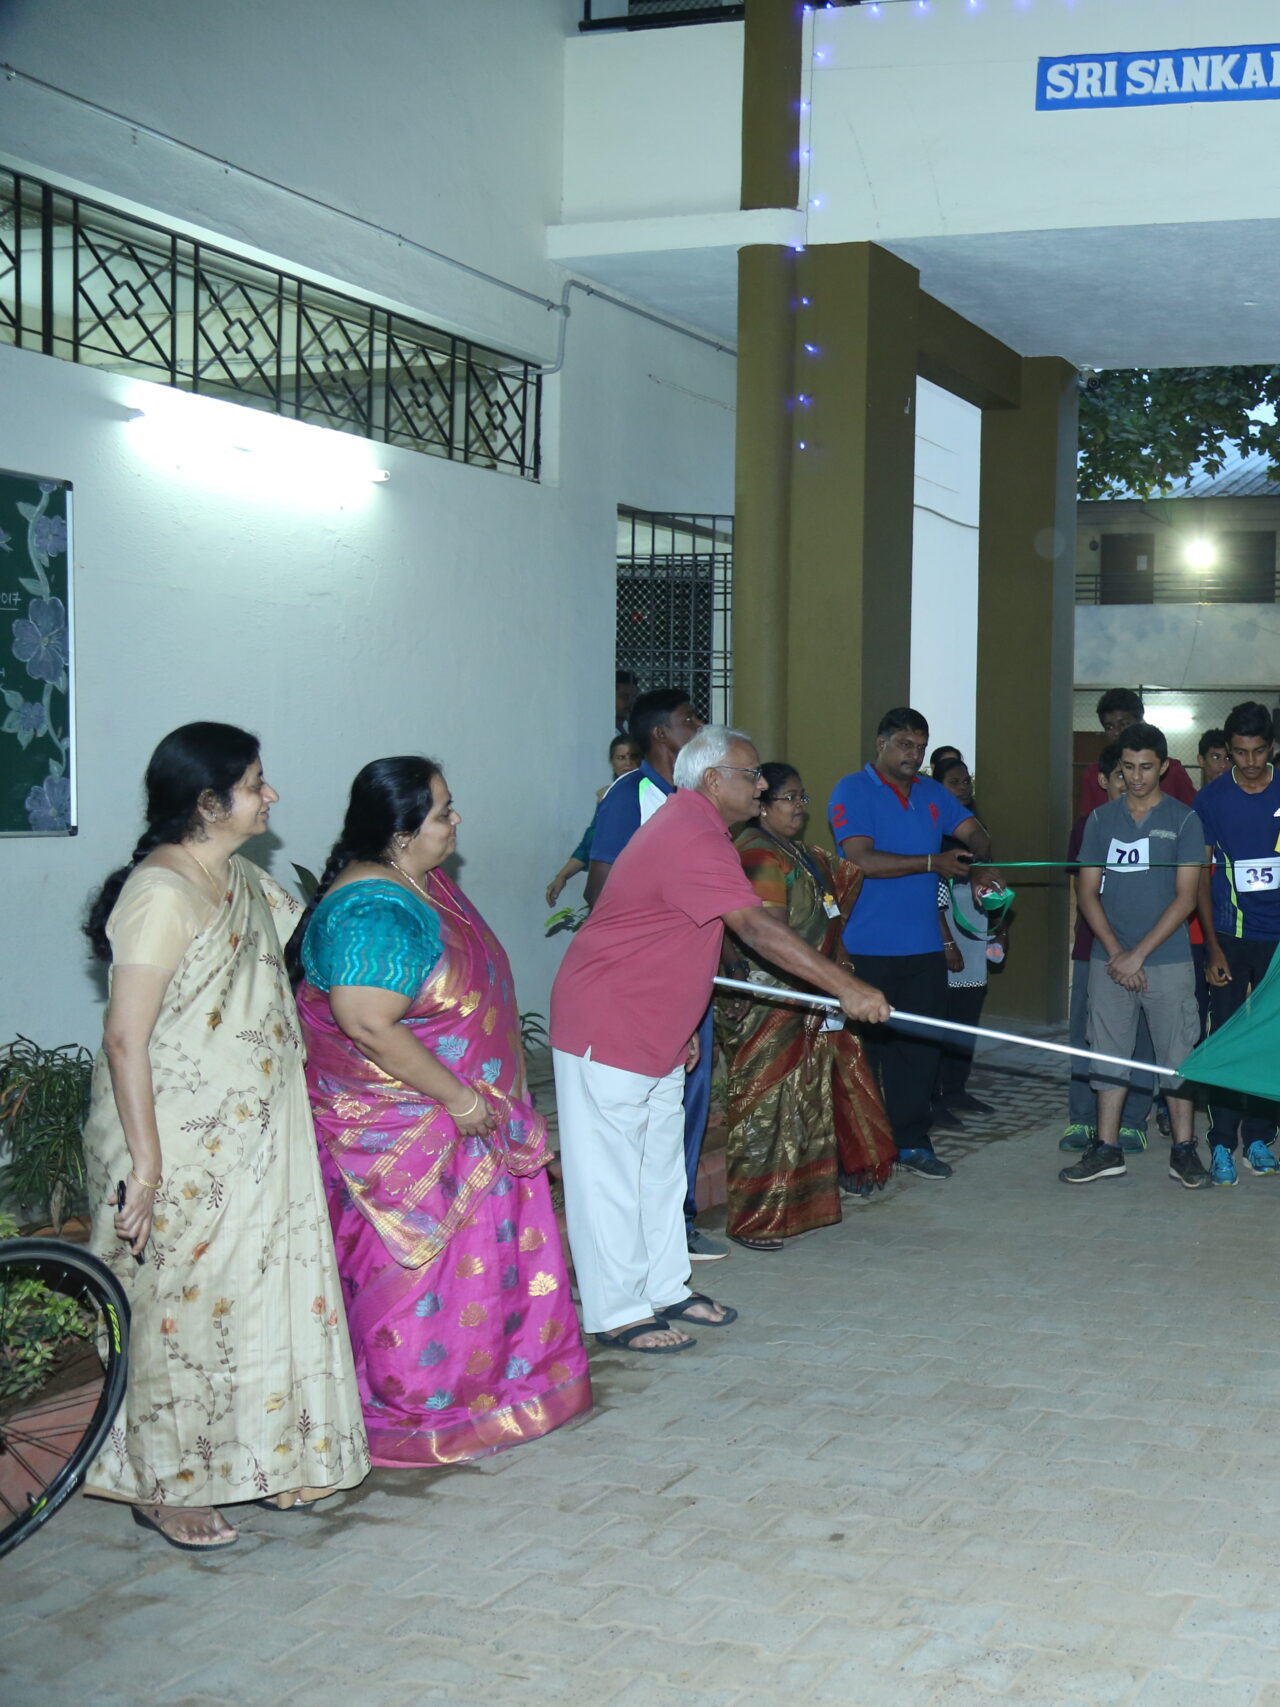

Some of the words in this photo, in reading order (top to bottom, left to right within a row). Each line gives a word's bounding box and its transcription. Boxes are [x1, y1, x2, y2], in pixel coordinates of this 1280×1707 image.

[1046, 61, 1118, 100] SRI
[0, 592, 21, 606] 017
[1115, 848, 1140, 864] 70
[1246, 867, 1274, 885] 35
